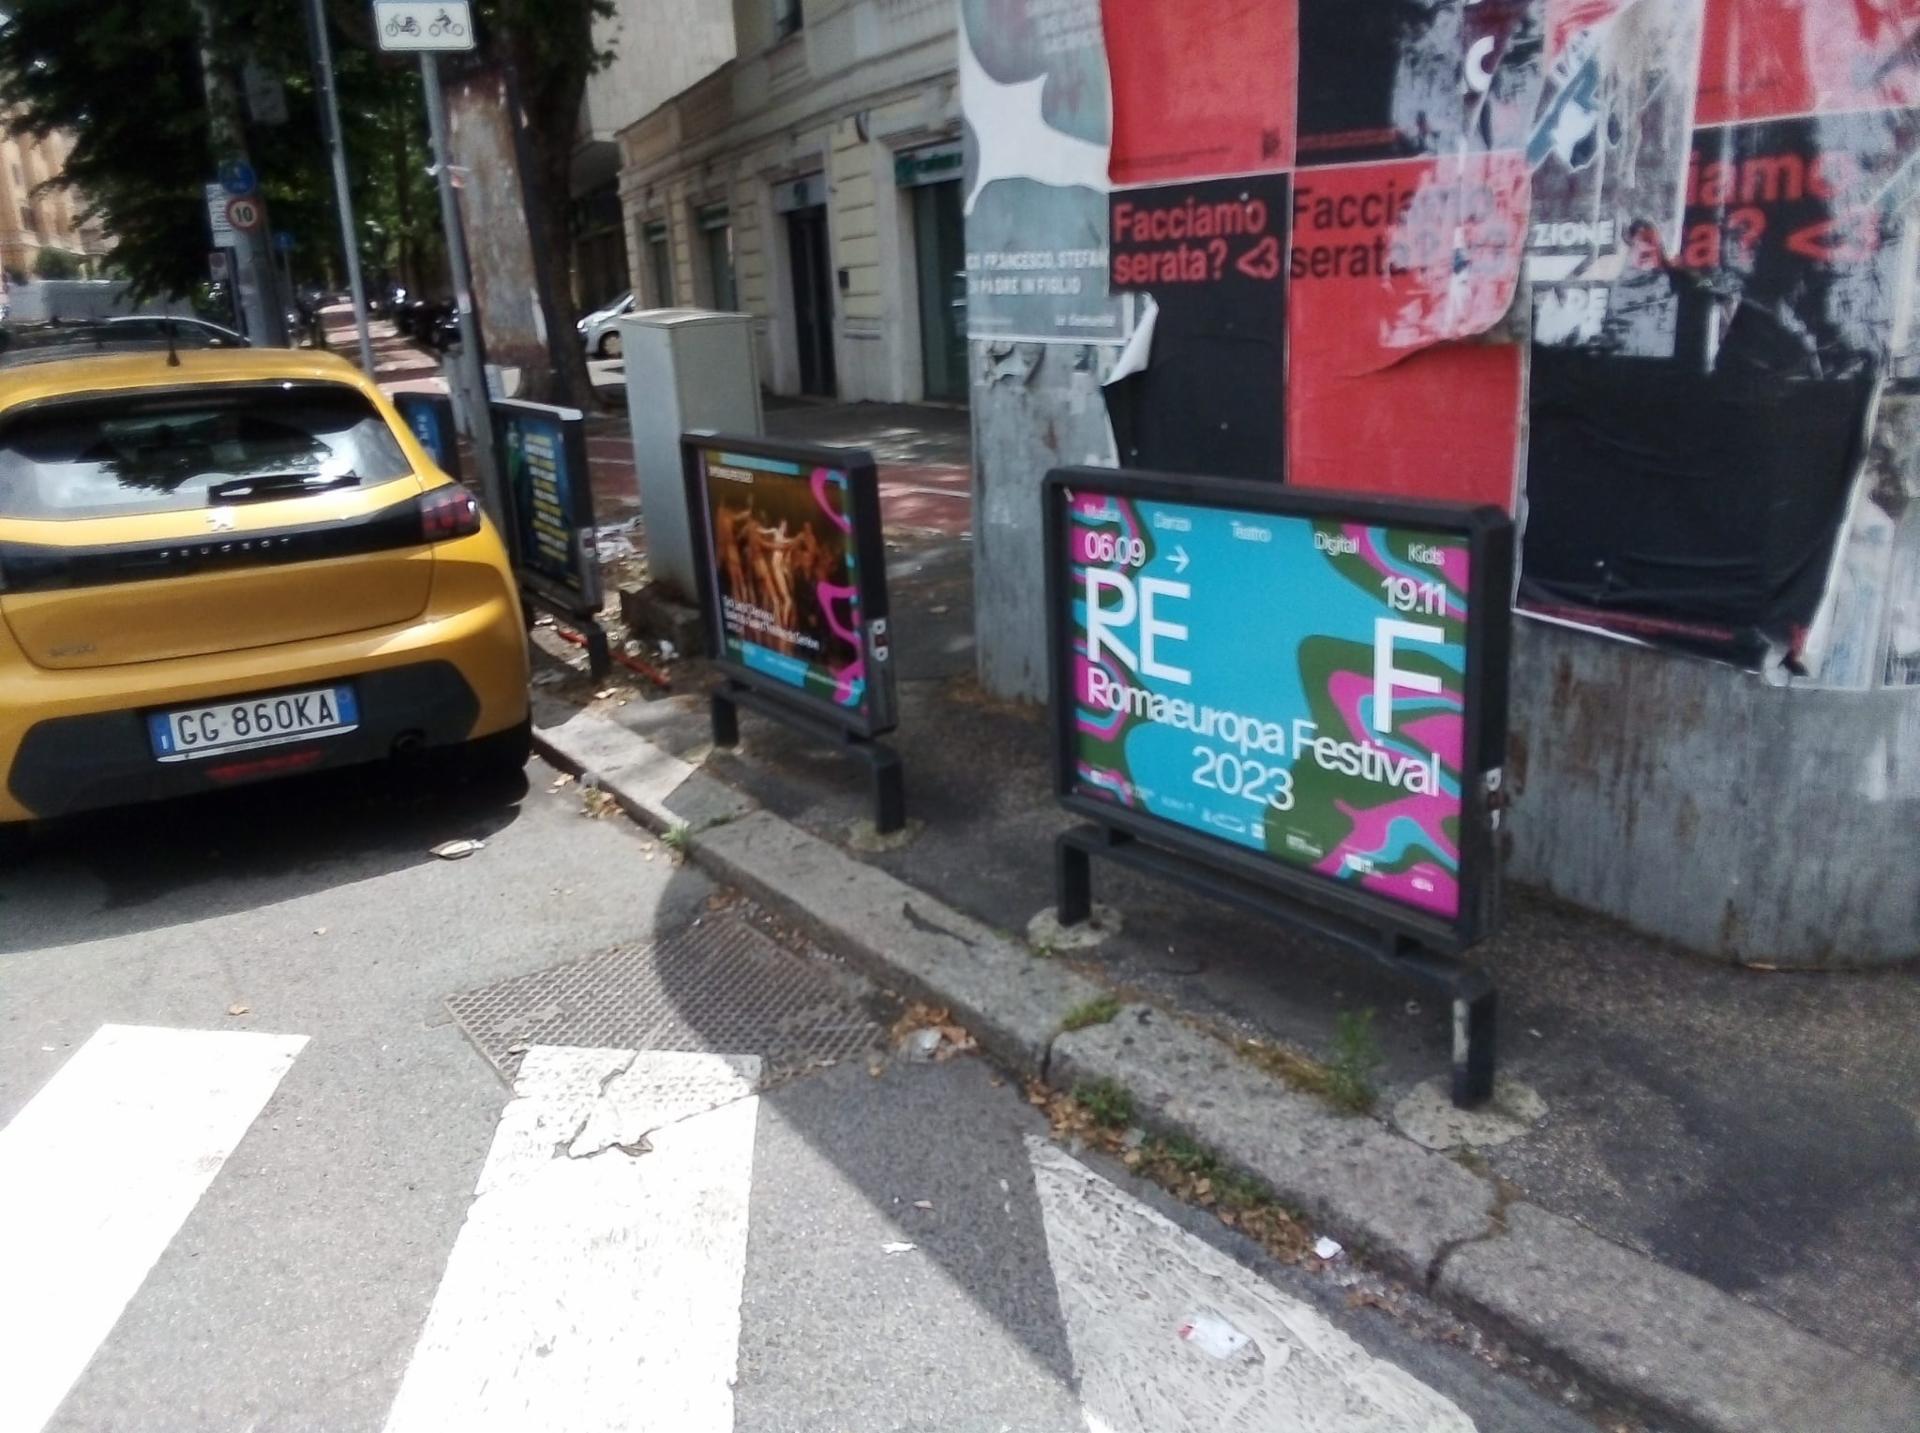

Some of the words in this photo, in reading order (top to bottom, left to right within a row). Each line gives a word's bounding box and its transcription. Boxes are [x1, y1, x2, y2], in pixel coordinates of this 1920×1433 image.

[235, 206, 253, 223] 10
[1114, 196, 1267, 243] Facciamo
[1114, 237, 1228, 285] serata?
[1314, 531, 1360, 556] Digital
[1408, 543, 1445, 566] Kids
[1381, 575, 1447, 616] 19.11
[1085, 566, 1191, 686] RE
[1373, 617, 1445, 734] F
[177, 711, 219, 746] GG
[231, 694, 335, 737] 860KA
[1087, 666, 1285, 758] Romaeuropa
[1292, 718, 1441, 798] Festival
[1191, 745, 1295, 812] 2023
